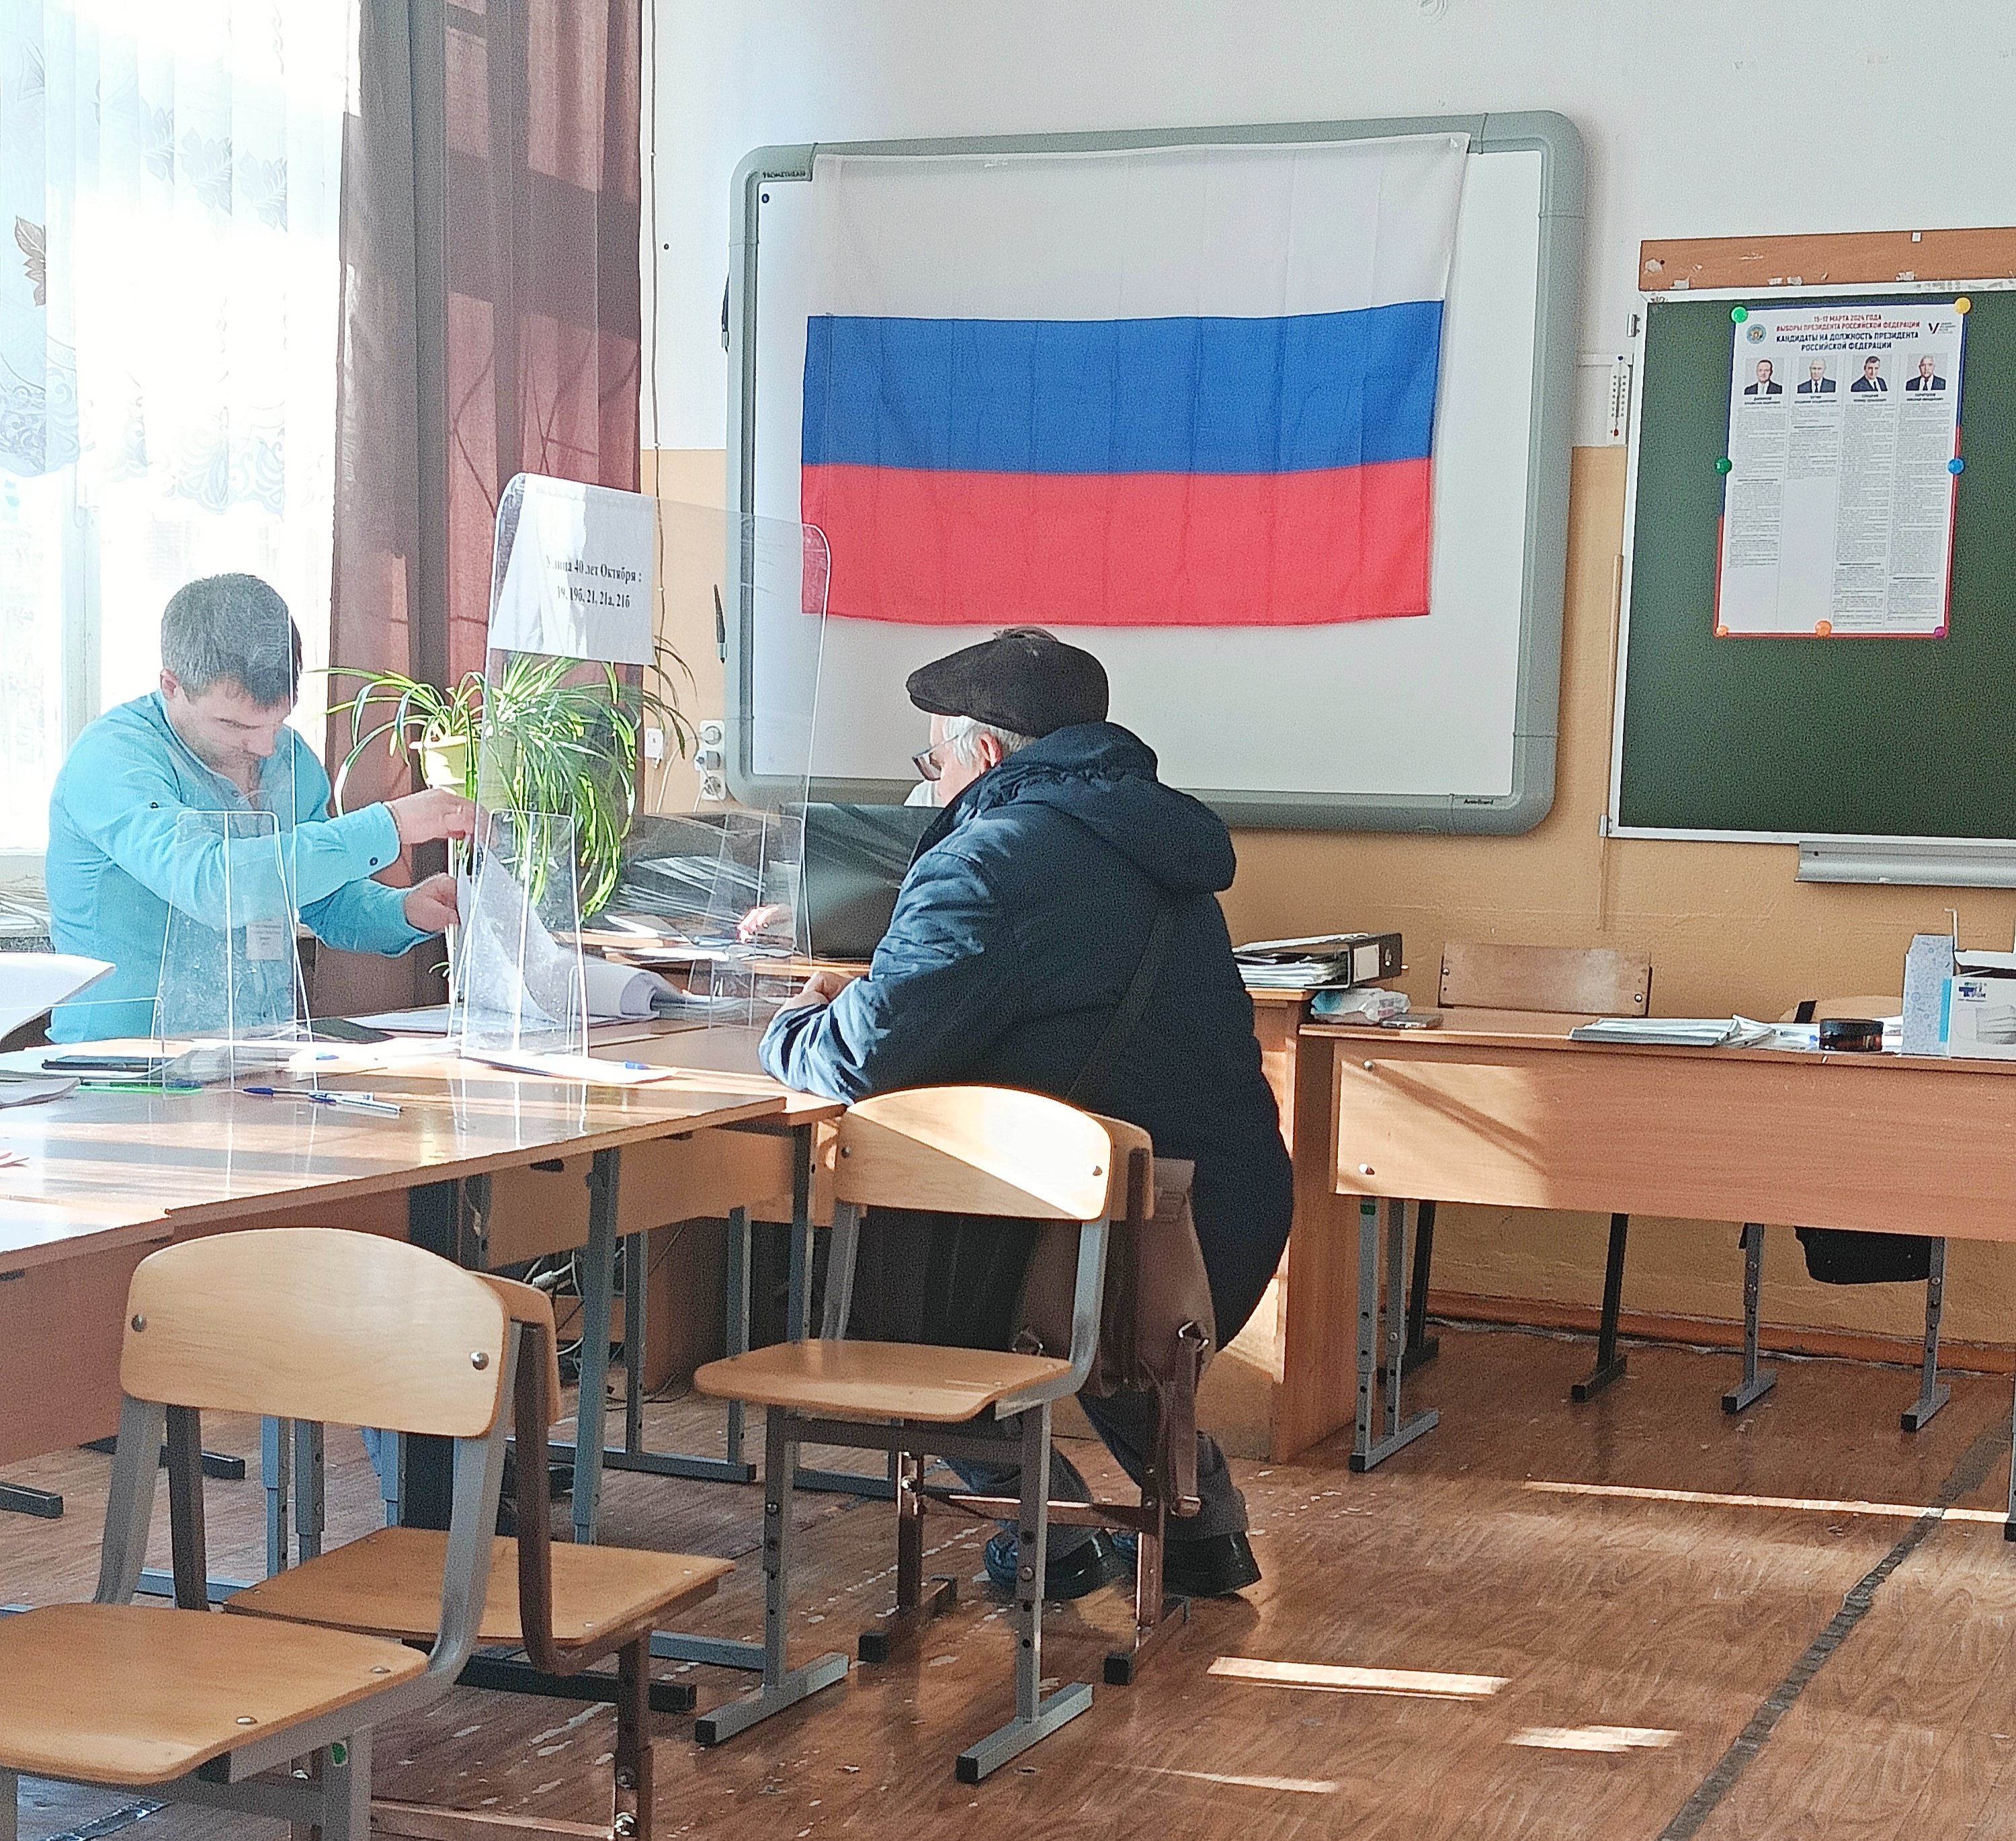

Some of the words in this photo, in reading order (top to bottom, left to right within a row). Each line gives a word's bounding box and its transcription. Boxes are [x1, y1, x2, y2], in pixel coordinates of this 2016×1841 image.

[1842, 321, 1882, 329] РОССИЙСКОЙ
[1829, 333, 1873, 341] ДОЛЖНОСТЬ
[1874, 331, 1919, 339] ПРЕЗИДЕНТА
[1801, 341, 1847, 351] РОССИЙСКОЙ
[1848, 341, 1892, 350] ФЕДЕРАЦИИ
[574, 559, 584, 573] 40
[585, 565, 599, 577] лет
[600, 563, 636, 585] Октября
[587, 589, 598, 605] 21,
[616, 593, 630, 608] 21б
